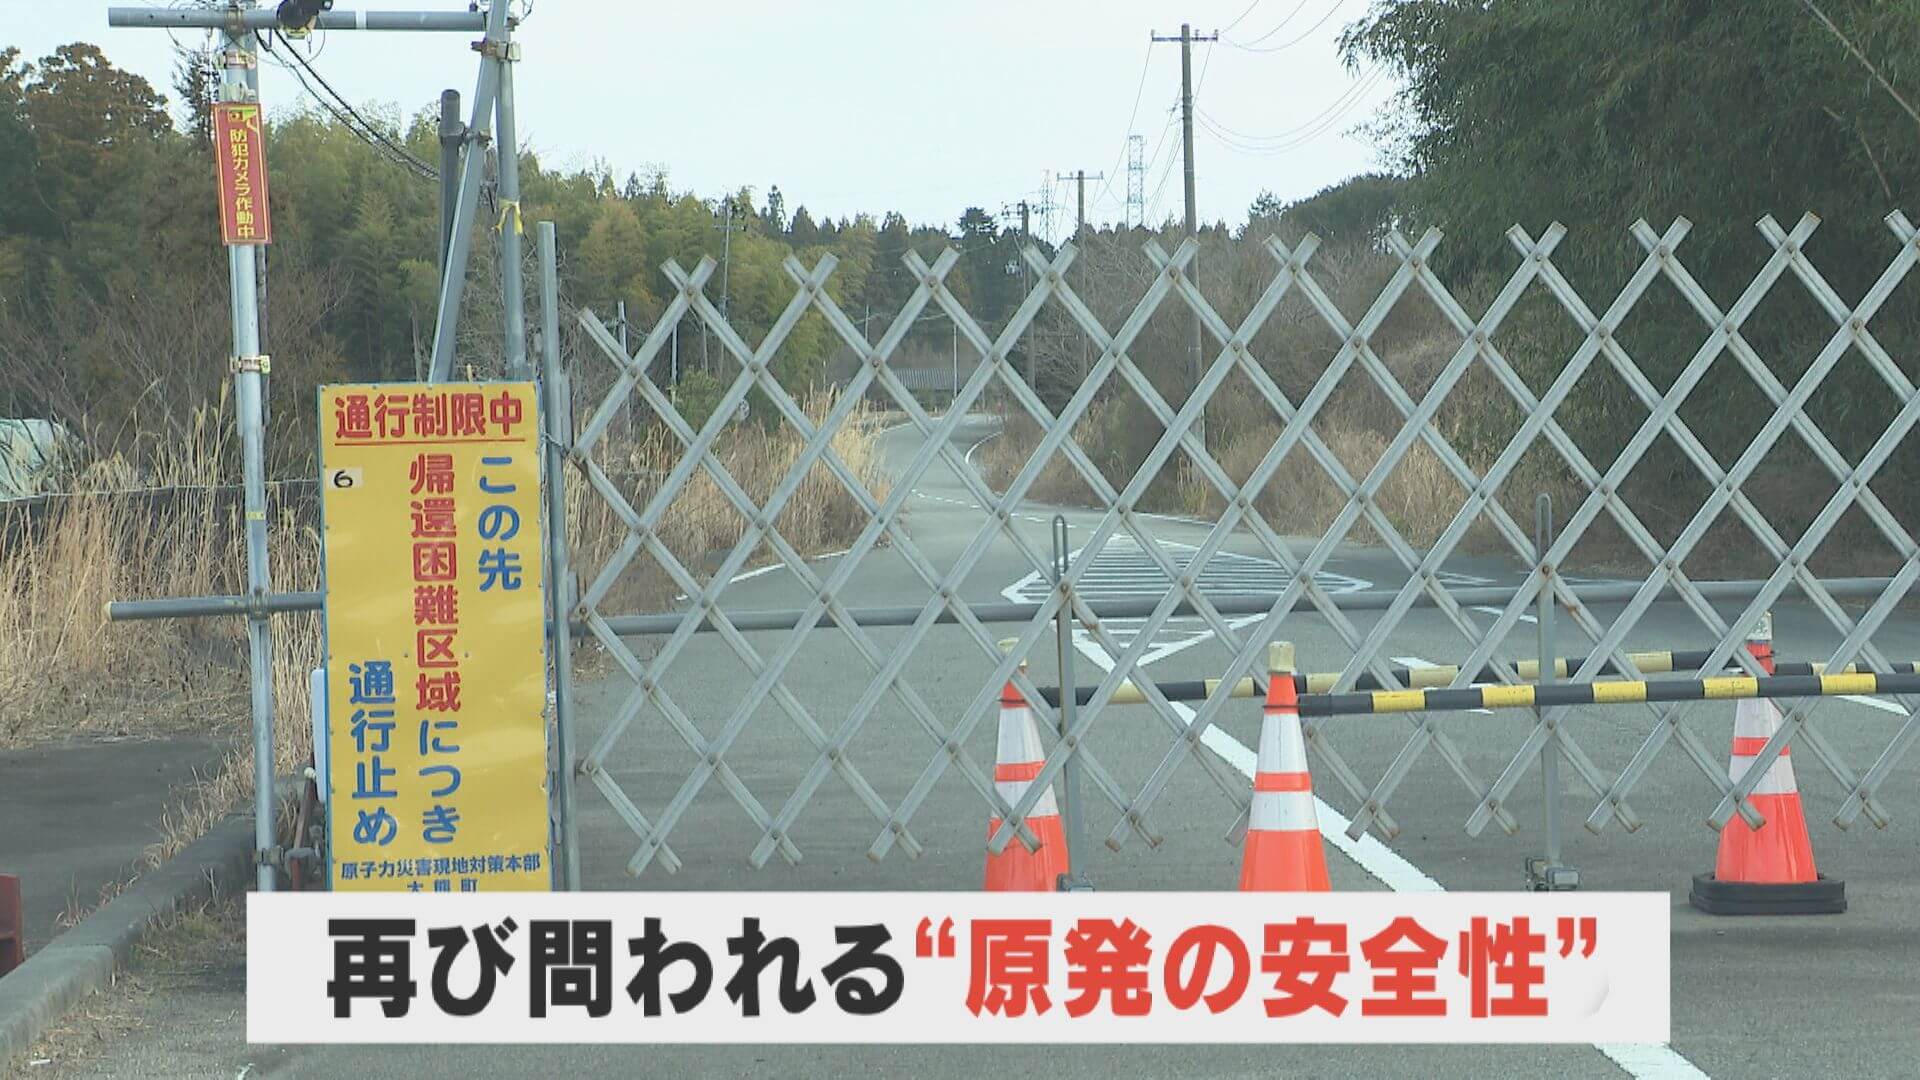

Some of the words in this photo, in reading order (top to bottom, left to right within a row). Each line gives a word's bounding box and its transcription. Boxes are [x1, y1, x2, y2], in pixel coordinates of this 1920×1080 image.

[230, 129, 254, 239] 防犯カメラ作動中
[335, 392, 522, 438] 通行制限中
[334, 470, 354, 489] 6
[478, 457, 522, 592] この先
[410, 453, 461, 845] 帰還困難区域につき
[349, 661, 398, 847] 通行止め
[341, 854, 541, 880] 原子力災害現地対策本部
